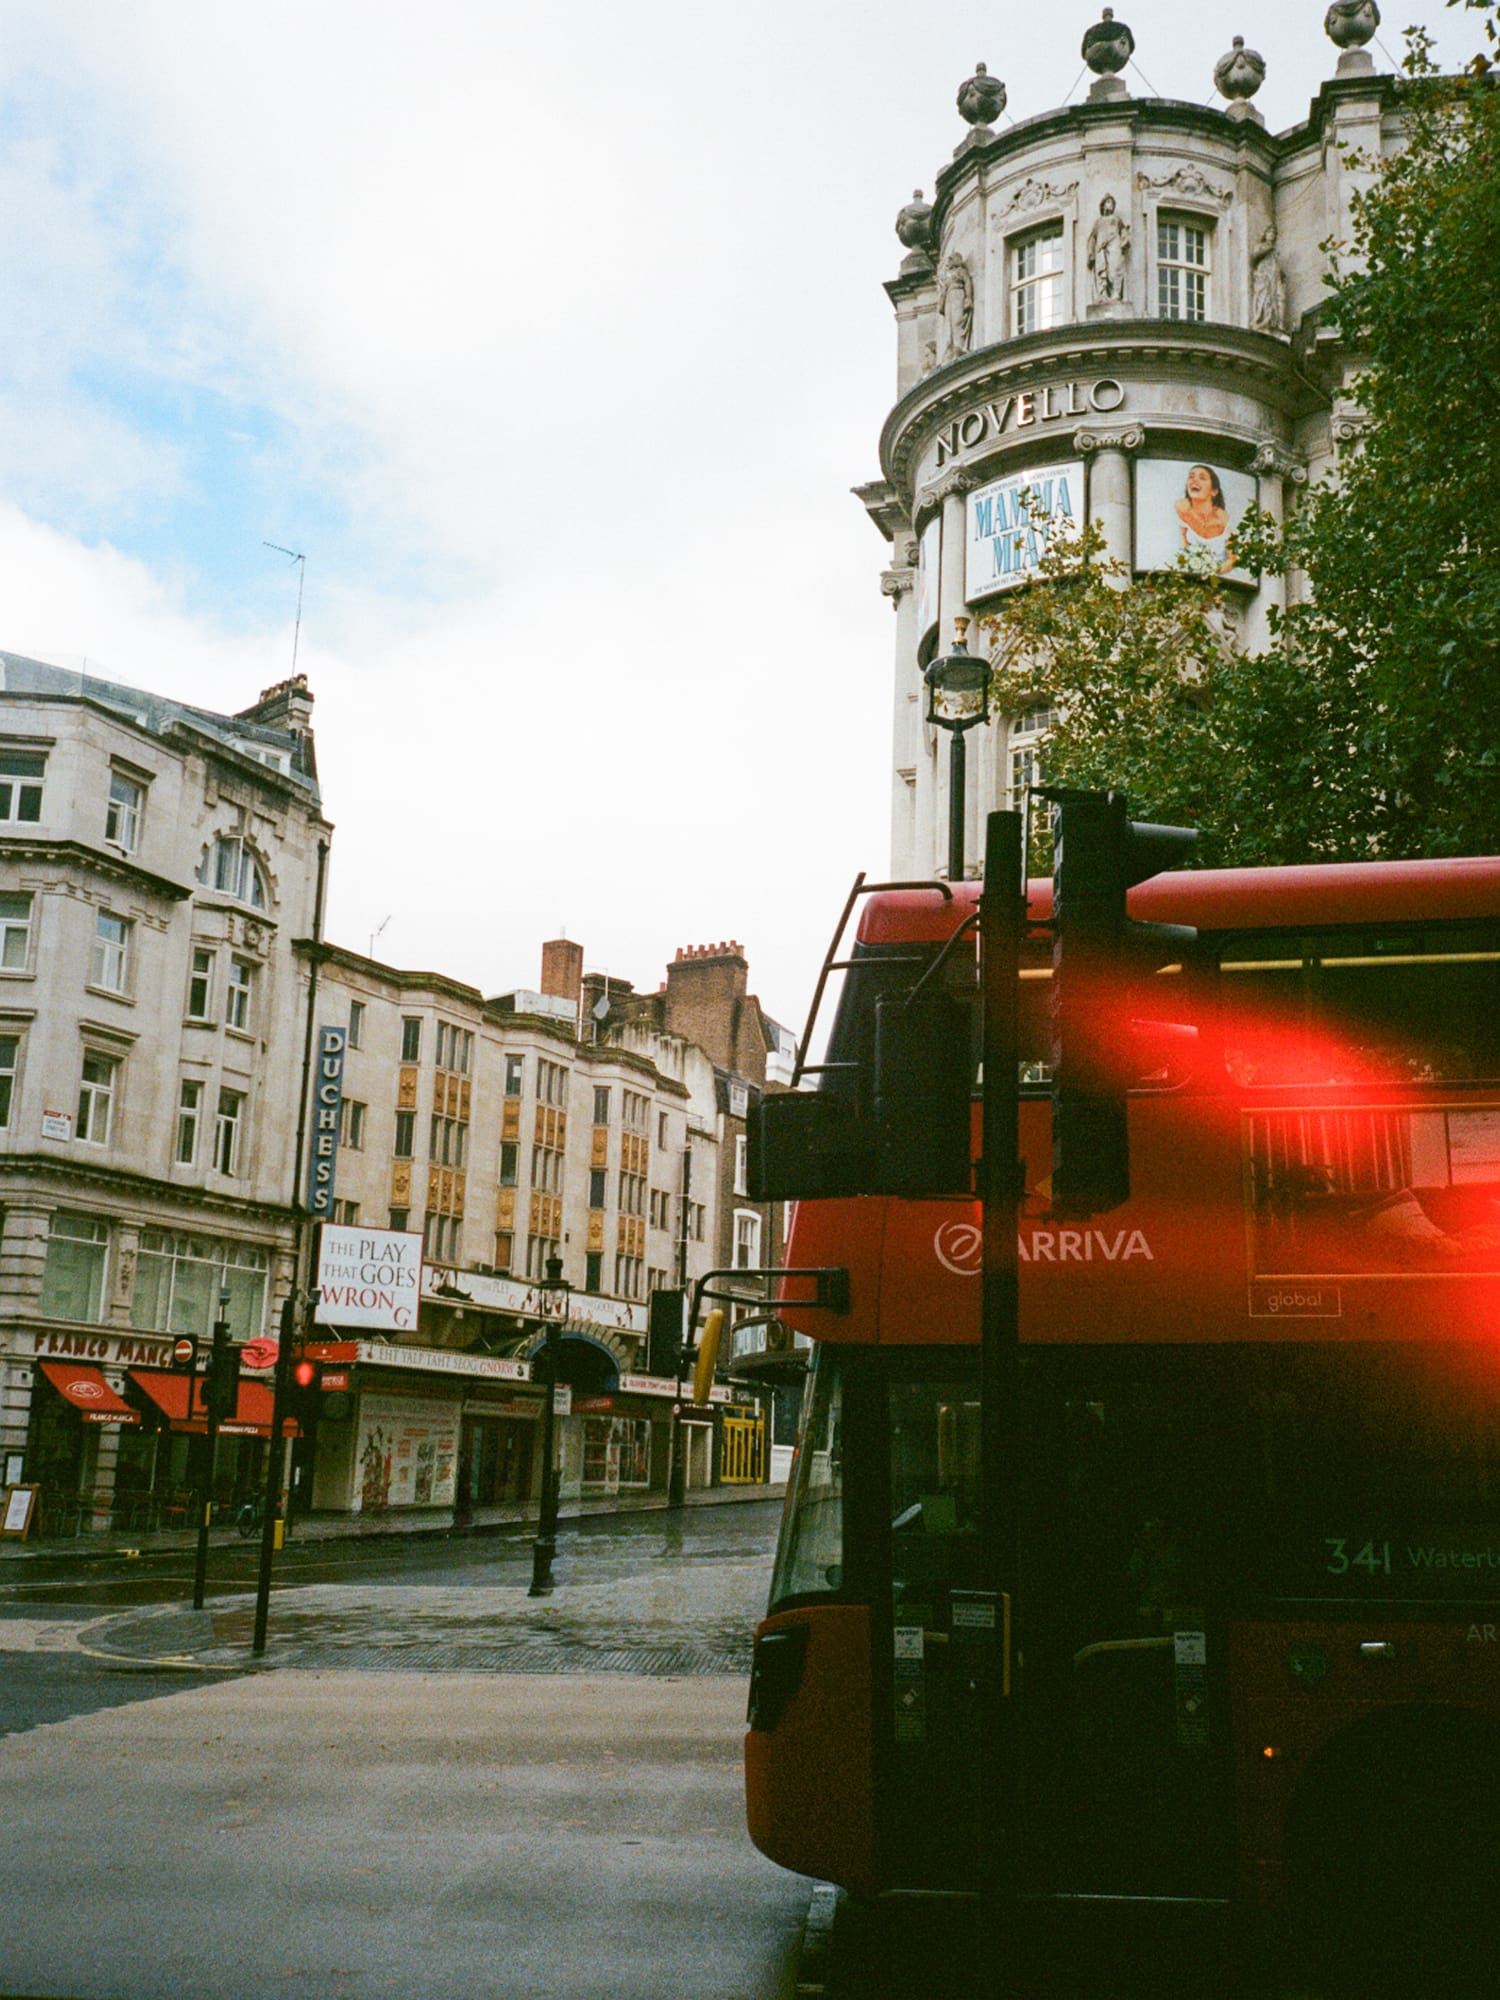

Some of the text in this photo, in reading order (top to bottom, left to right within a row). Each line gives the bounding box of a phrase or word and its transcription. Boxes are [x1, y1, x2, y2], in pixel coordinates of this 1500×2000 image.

[936, 378, 1124, 466] NOVELLO
[974, 477, 1072, 541] MAMMA
[314, 1032, 343, 1210] DUCHESS
[328, 1240, 407, 1263] THE PLAY
[322, 1263, 416, 1289] THAT GOES
[1267, 1290, 1321, 1312] global
[34, 1331, 173, 1367] FRANCO MANC
[1325, 1537, 1391, 1574] 341
